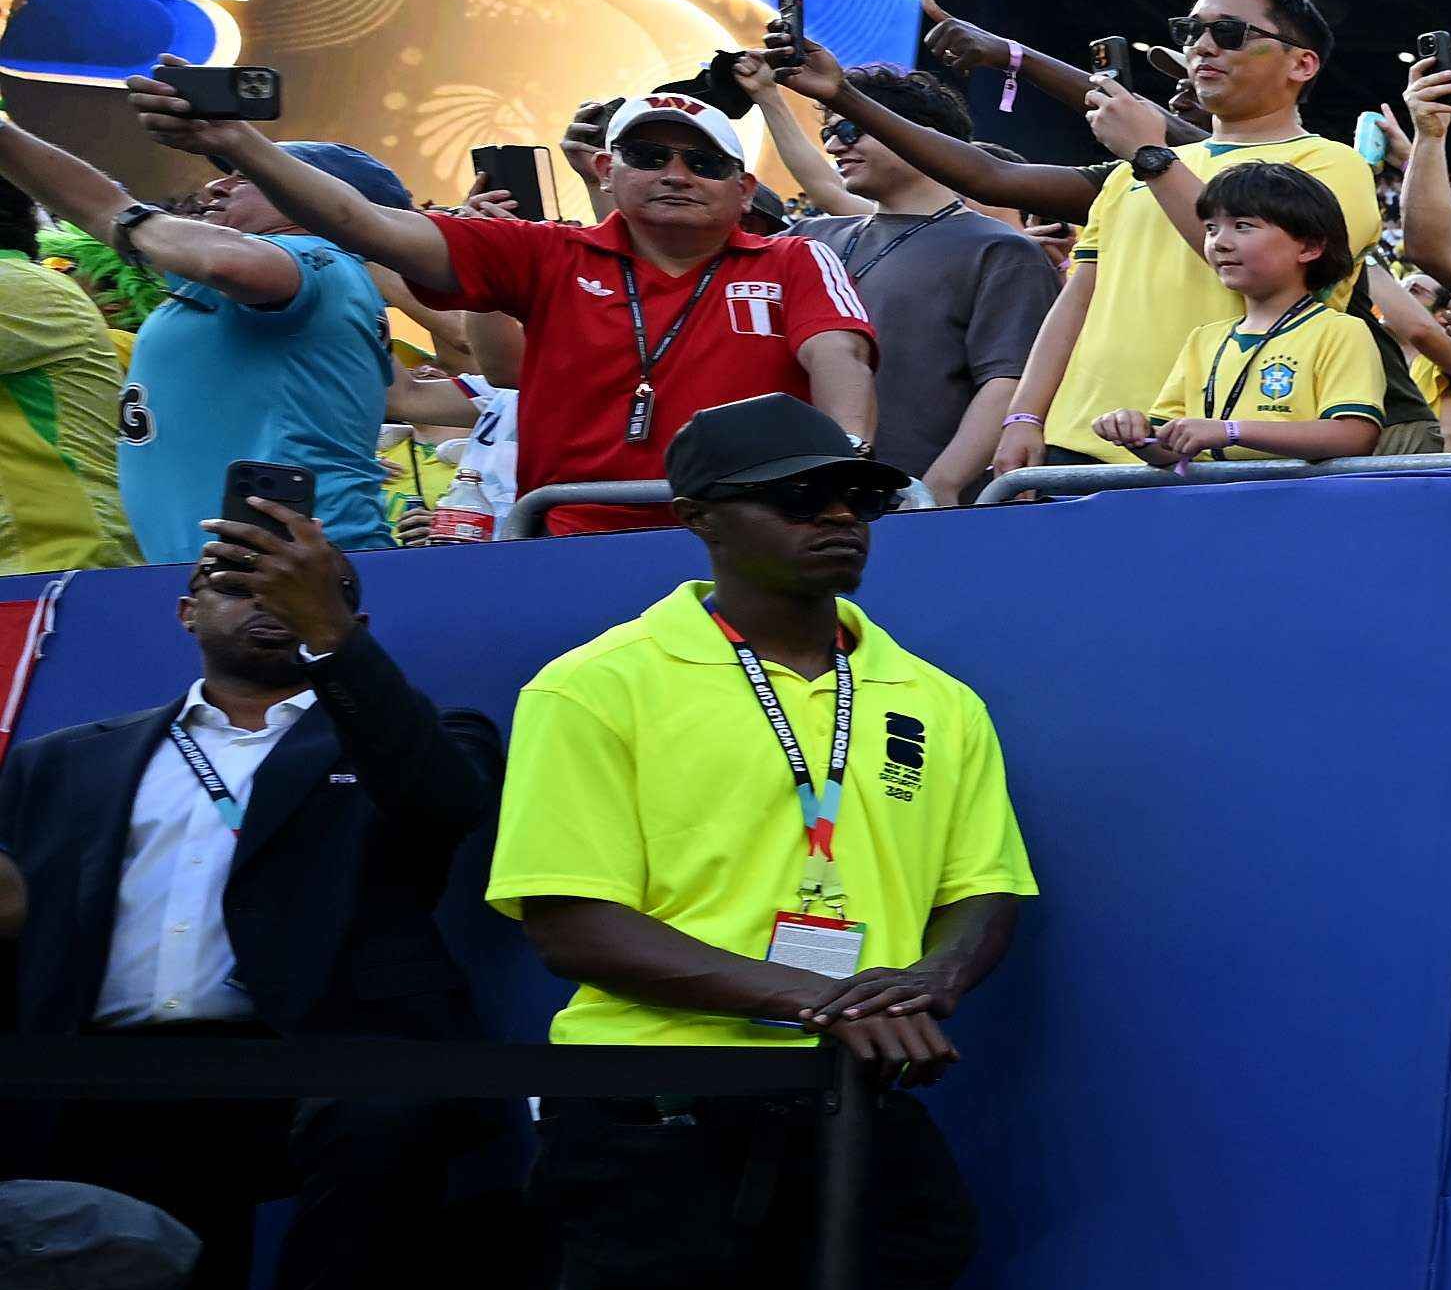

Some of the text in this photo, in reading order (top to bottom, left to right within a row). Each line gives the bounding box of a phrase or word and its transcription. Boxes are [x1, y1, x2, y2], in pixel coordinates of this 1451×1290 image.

[732, 283, 779, 296] FPF
[756, 685, 777, 707] CUP
[838, 673, 852, 708] WORLD
[767, 708, 796, 747] WORLD
[837, 708, 850, 730] CUP
[787, 748, 806, 772] FIFA
